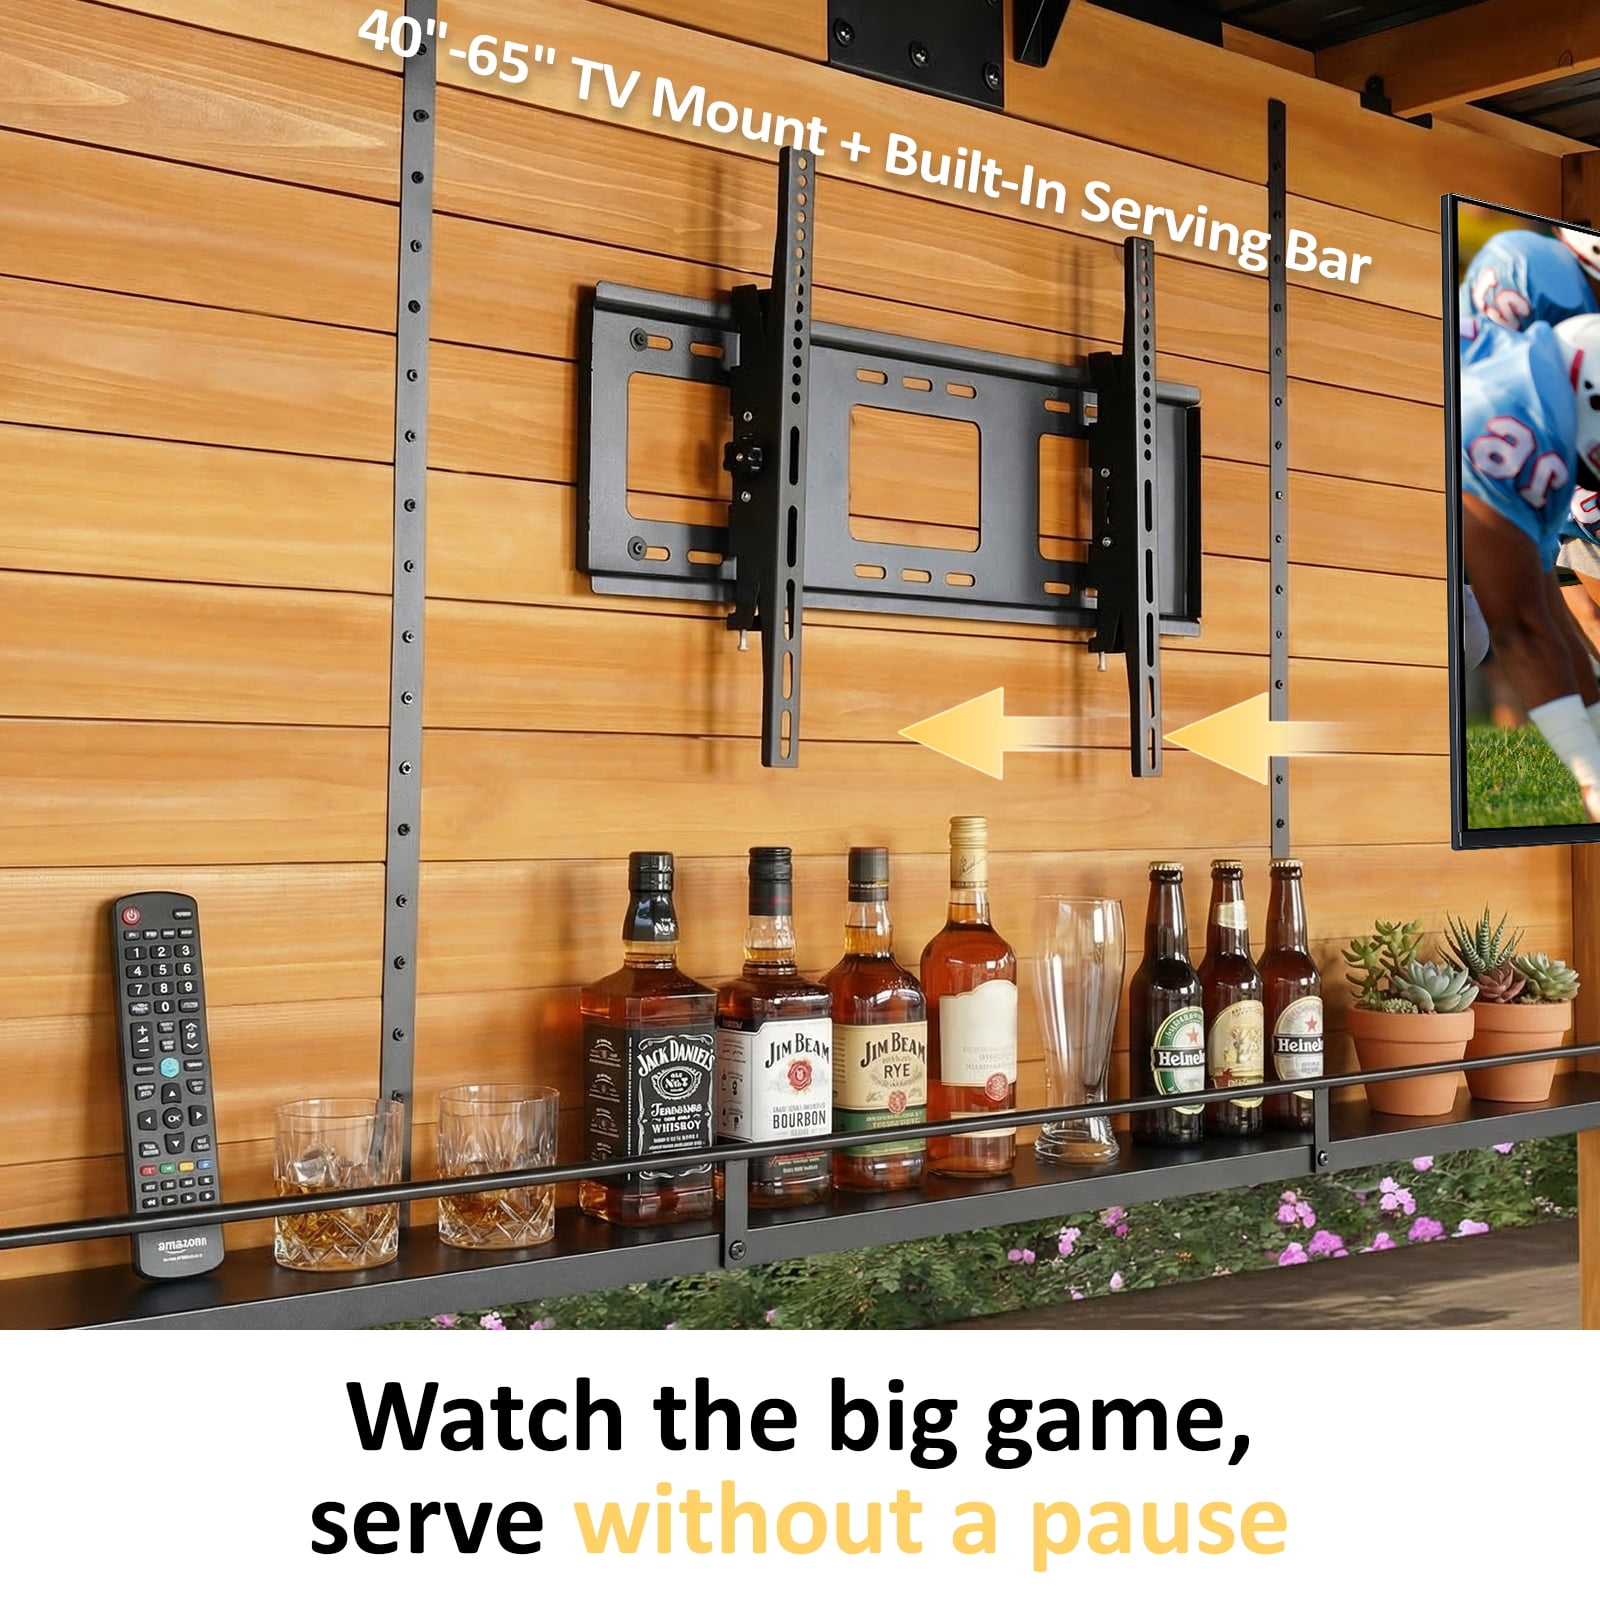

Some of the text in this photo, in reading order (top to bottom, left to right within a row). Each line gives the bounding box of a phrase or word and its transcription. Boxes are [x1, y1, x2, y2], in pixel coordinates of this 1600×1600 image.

[158, 946, 166, 957] 2
[182, 945, 190, 956] 3
[133, 963, 192, 976] 4 5 6
[135, 981, 193, 995] 7 8 9
[161, 1001, 169, 1013] 0
[764, 1040, 792, 1069] JIM
[795, 1032, 830, 1064] BEAM
[860, 1038, 889, 1068] JIM
[891, 1031, 926, 1064] BEAM
[637, 1045, 670, 1077] JACK
[884, 1062, 911, 1079] RYE
[167, 1113, 182, 1123] OK
[772, 1109, 828, 1130] BOURBON
